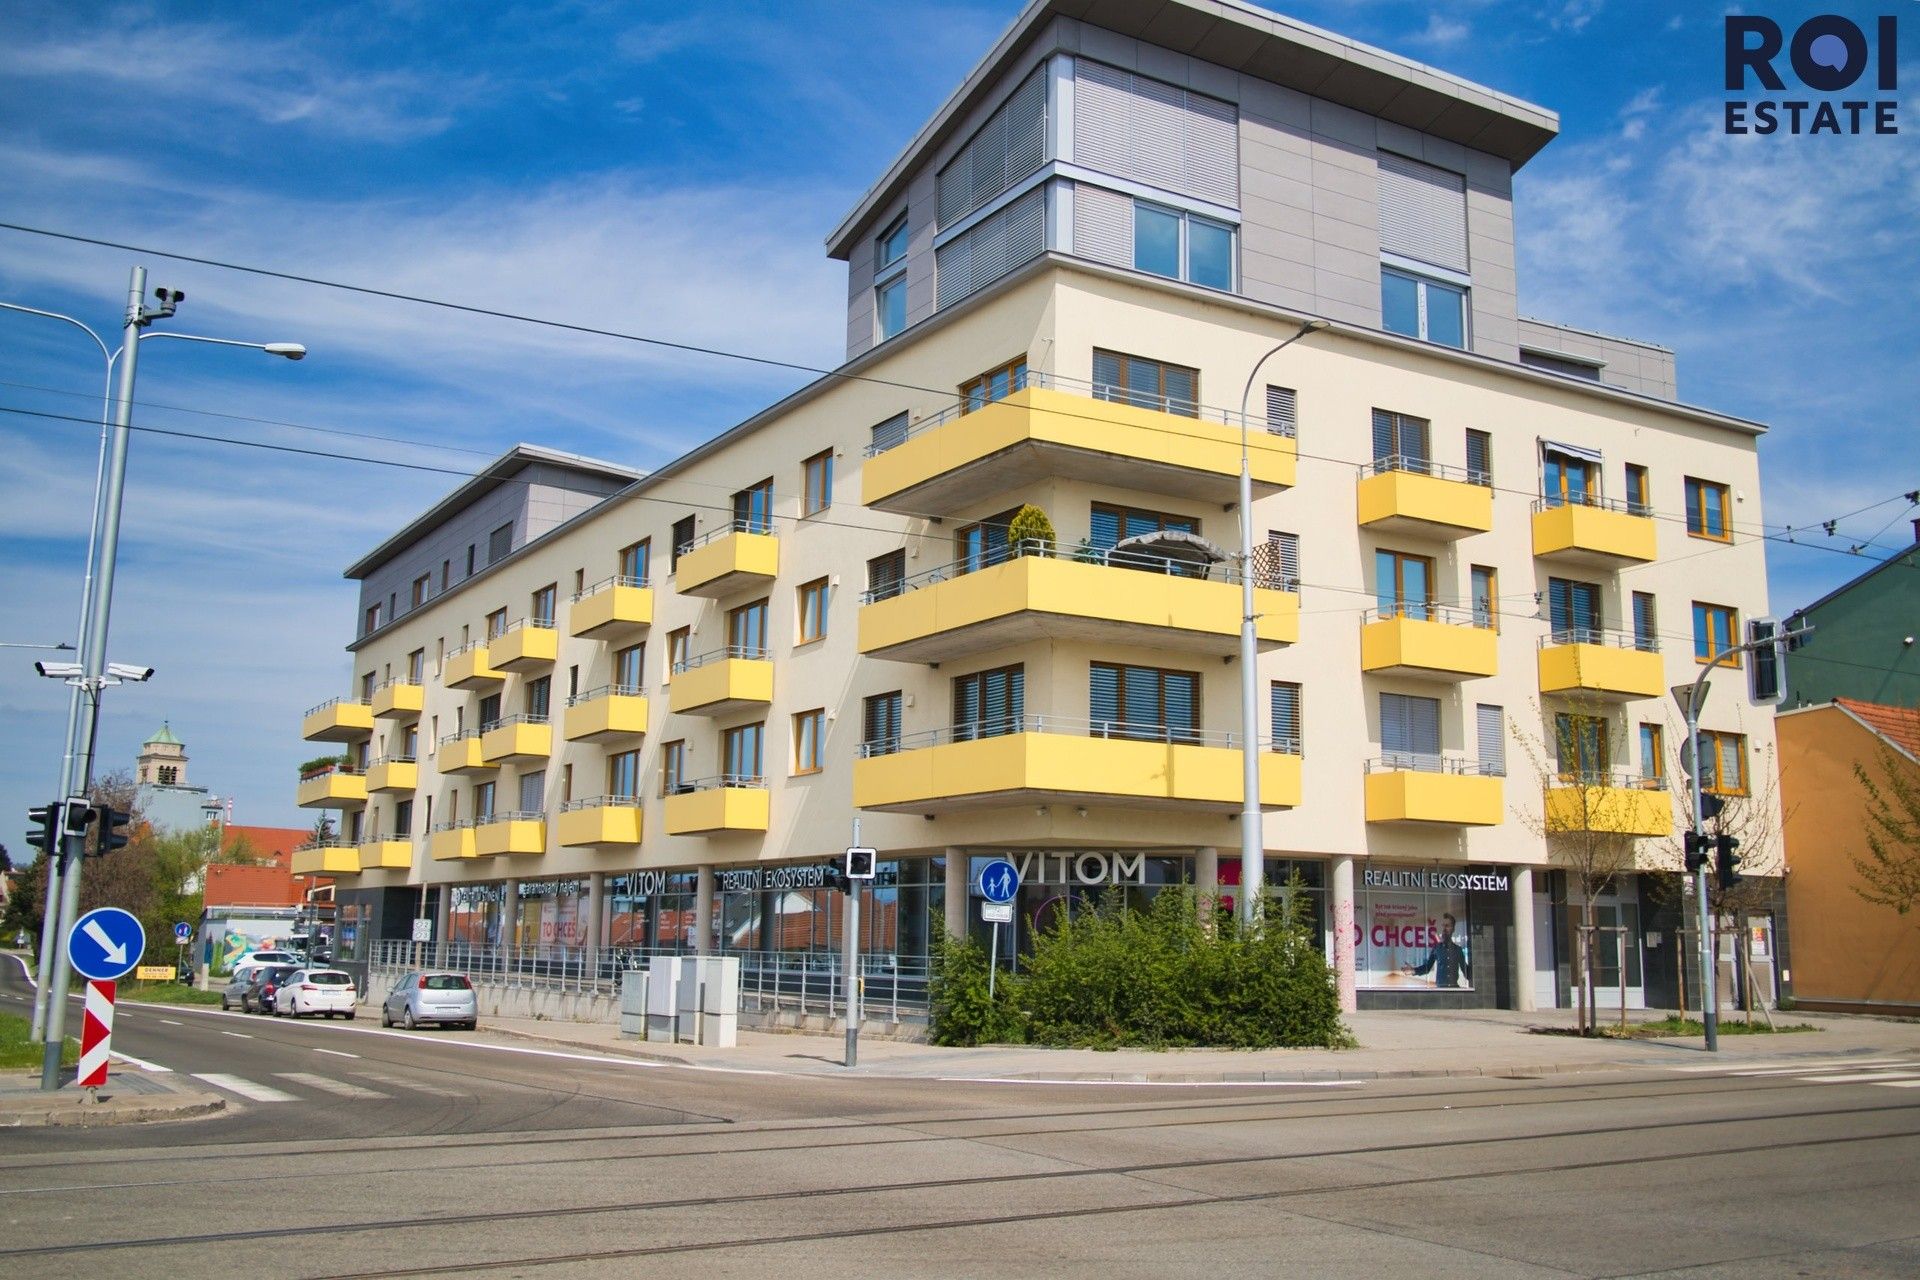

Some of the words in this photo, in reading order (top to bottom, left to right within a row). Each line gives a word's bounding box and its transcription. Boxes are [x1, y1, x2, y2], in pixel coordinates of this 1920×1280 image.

[1006, 851, 1145, 885] VITOM
[1364, 868, 1425, 887] REALITNÍ
[1431, 871, 1508, 891] EKOSYSTÉM
[626, 870, 666, 896] VITOM
[1371, 919, 1438, 949] CHCEŠ
